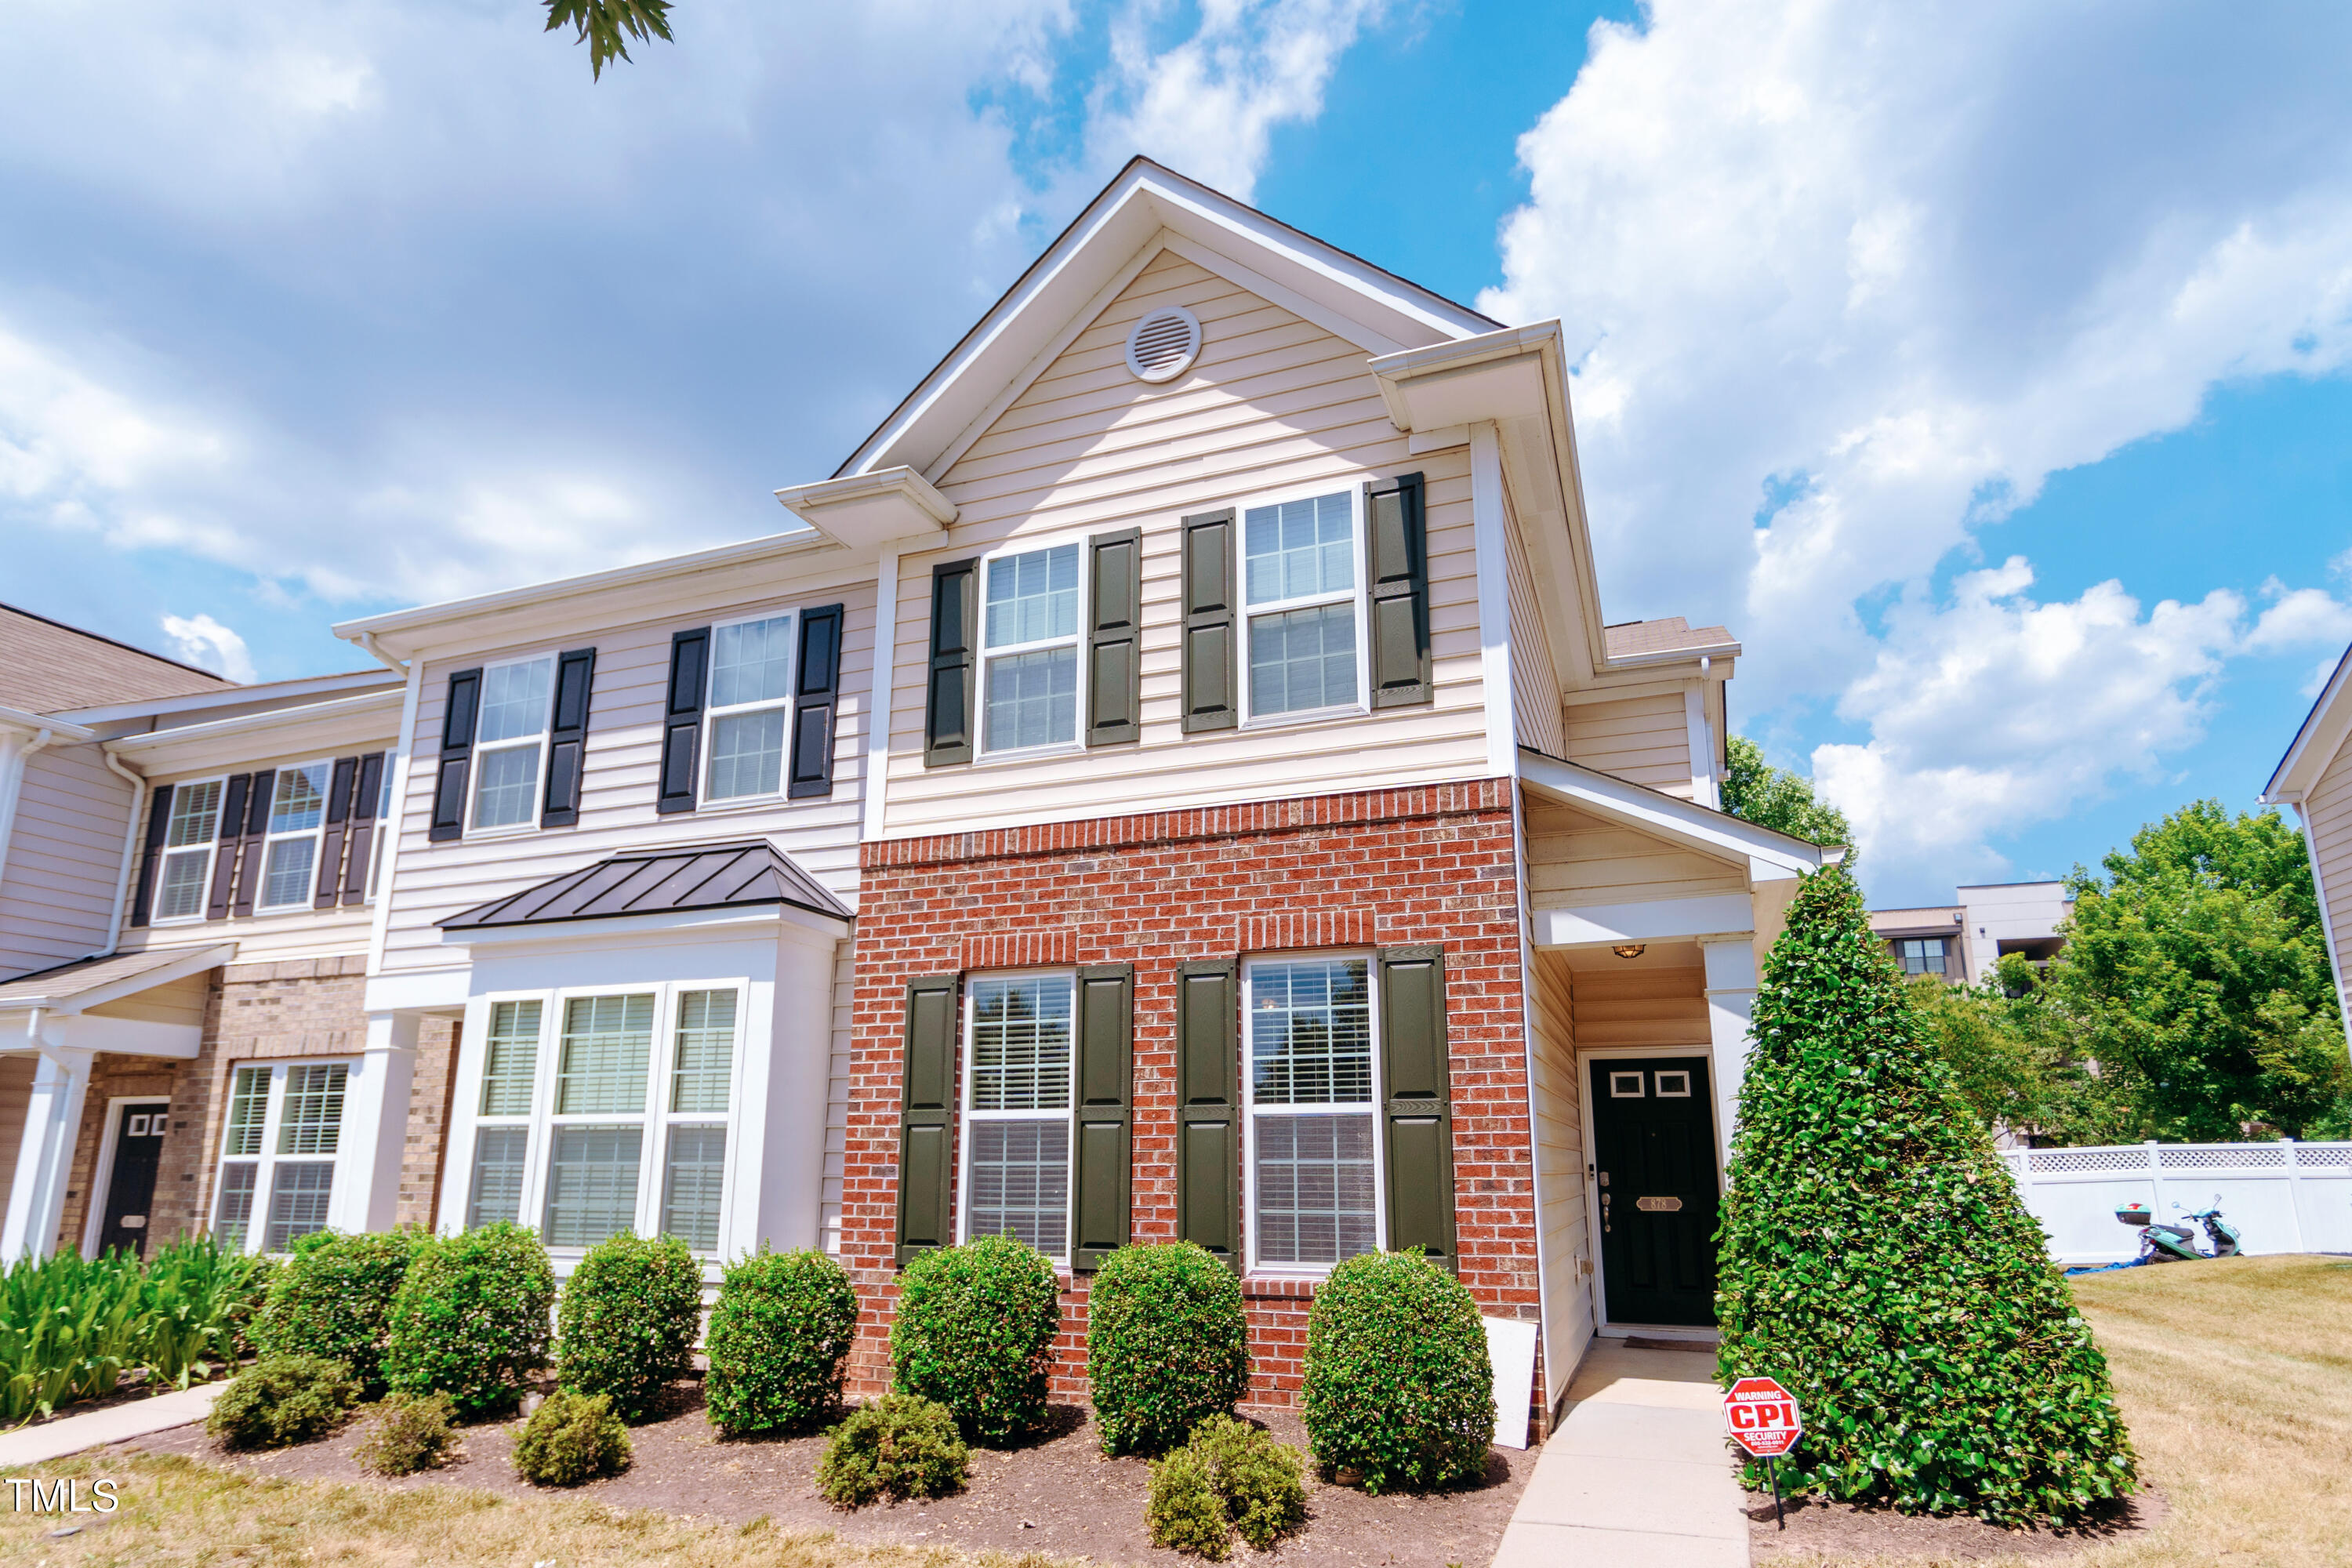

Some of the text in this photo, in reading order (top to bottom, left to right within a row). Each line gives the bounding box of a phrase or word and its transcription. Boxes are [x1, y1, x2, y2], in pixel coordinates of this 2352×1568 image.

[1650, 1199, 1667, 1210] 878
[1734, 1391, 1782, 1401] WARNING
[1730, 1403, 1795, 1428] CPI
[1744, 1431, 1787, 1441] SECURITY
